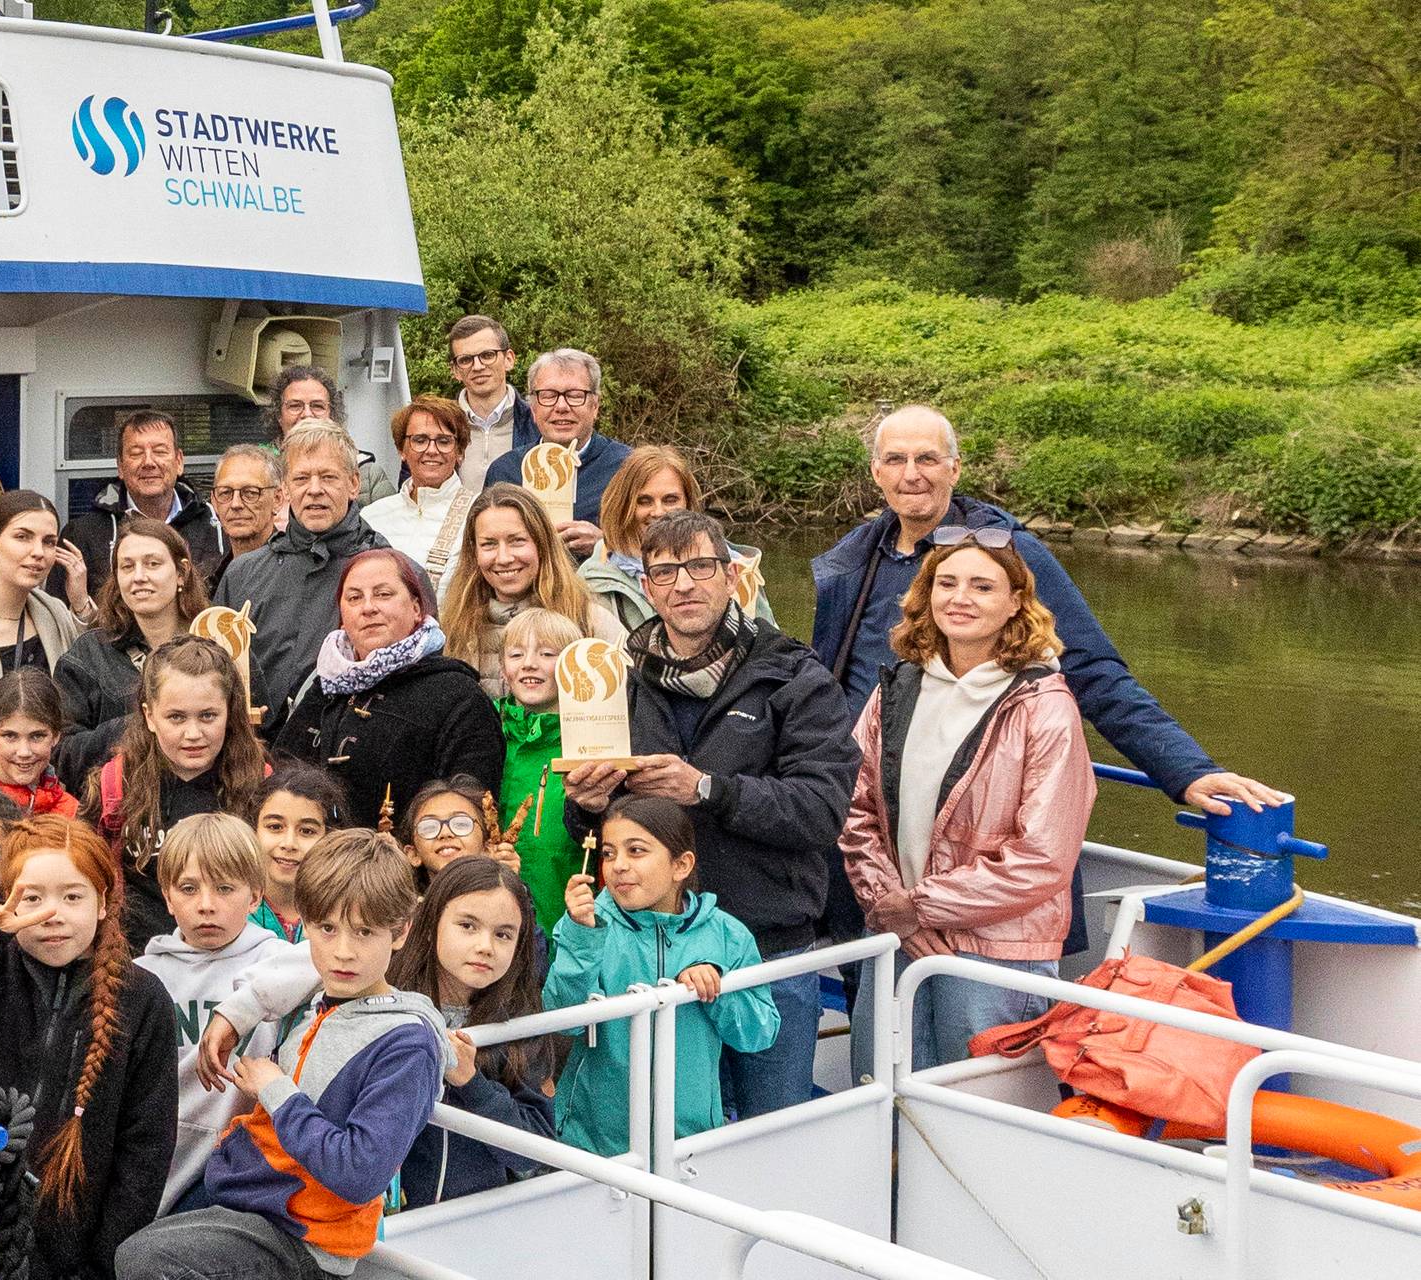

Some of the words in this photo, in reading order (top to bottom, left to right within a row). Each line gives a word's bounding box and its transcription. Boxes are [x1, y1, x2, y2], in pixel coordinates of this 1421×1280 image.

[154, 108, 340, 155] STADTWERKE
[158, 143, 261, 178] WITTEN
[164, 177, 306, 214] SCHWALBE
